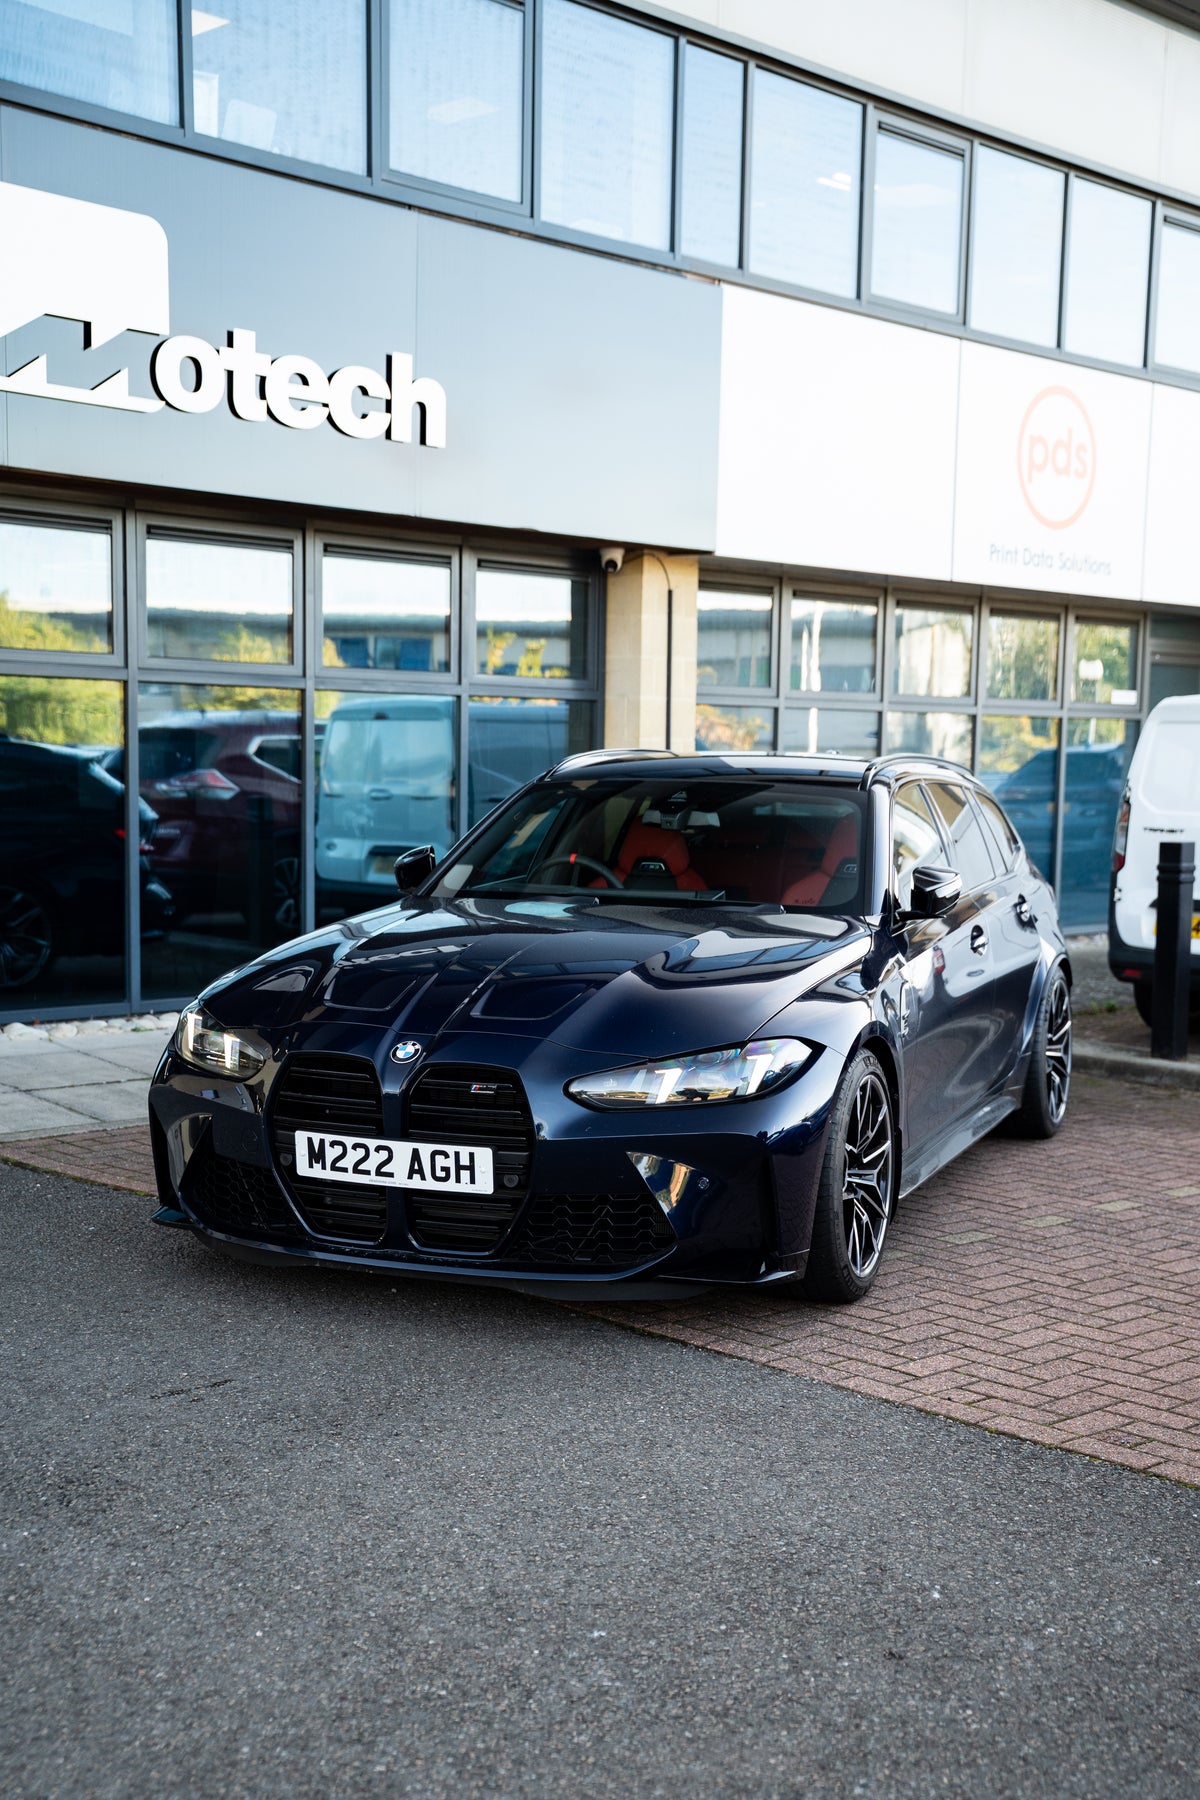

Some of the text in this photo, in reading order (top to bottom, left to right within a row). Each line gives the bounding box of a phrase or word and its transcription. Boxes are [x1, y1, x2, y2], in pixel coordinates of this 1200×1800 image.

[1028, 427, 1087, 483] pds
[989, 543, 1112, 576] Print Data Solutions
[307, 1136, 476, 1185] M222 AGH
